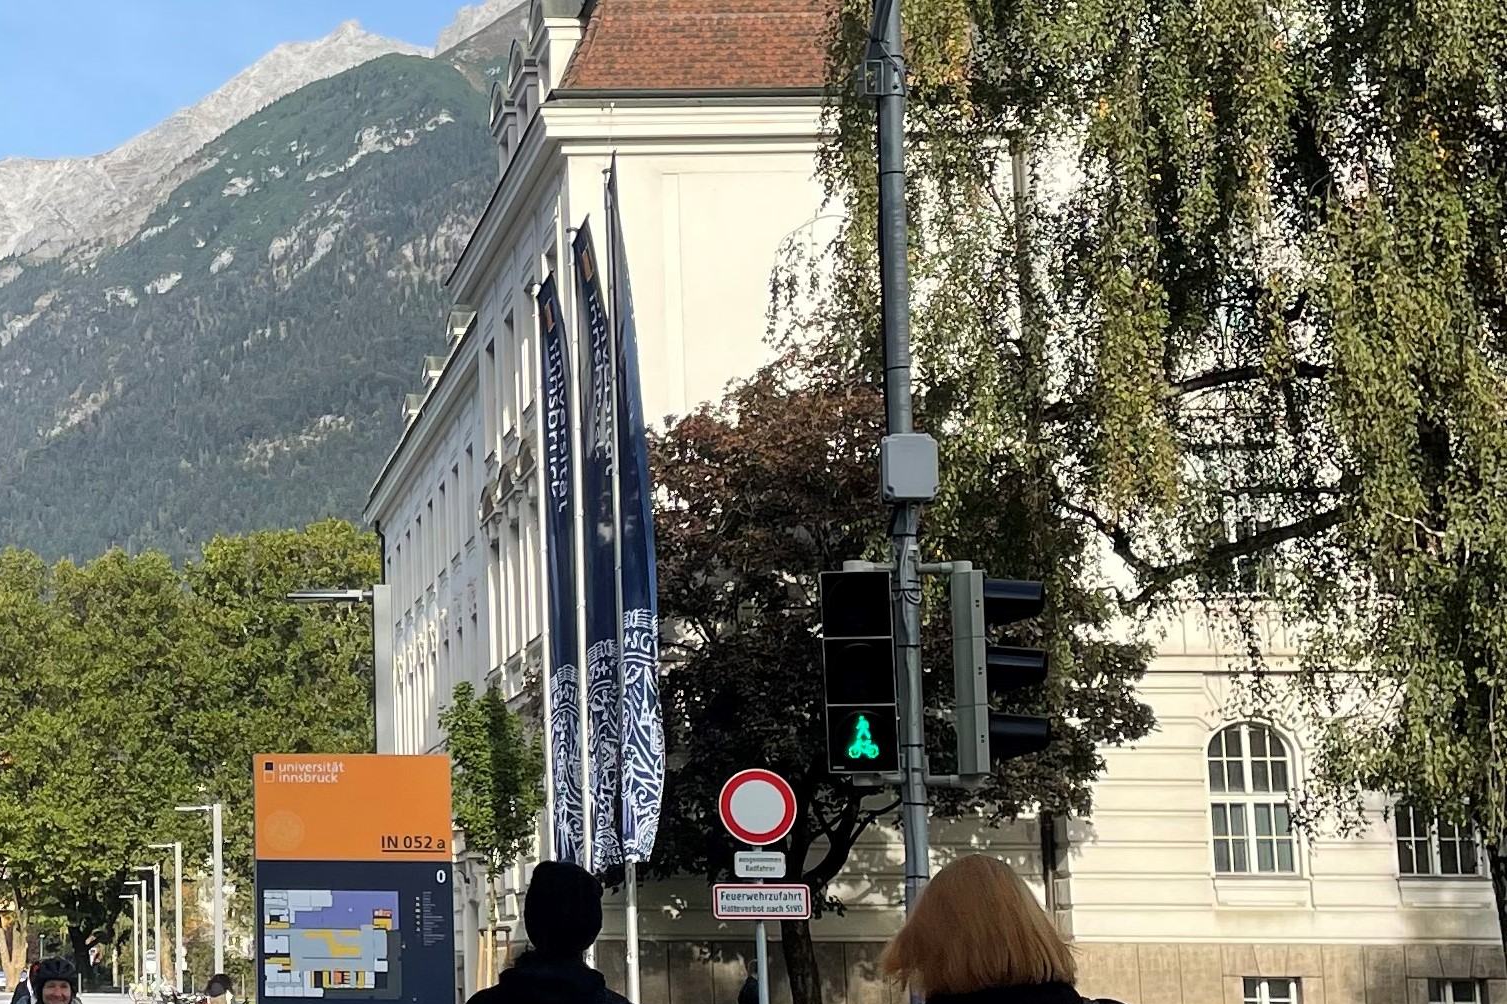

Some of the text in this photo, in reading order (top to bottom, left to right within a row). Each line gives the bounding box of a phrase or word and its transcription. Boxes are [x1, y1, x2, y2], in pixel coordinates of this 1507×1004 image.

[278, 761, 345, 773] universität
[278, 772, 339, 784] innsbruck
[381, 835, 446, 849] IN 052 a
[435, 869, 447, 884] 0
[720, 890, 802, 901] Feuerwehrzufahrt
[721, 904, 803, 913] Halteverbot nach StVO
